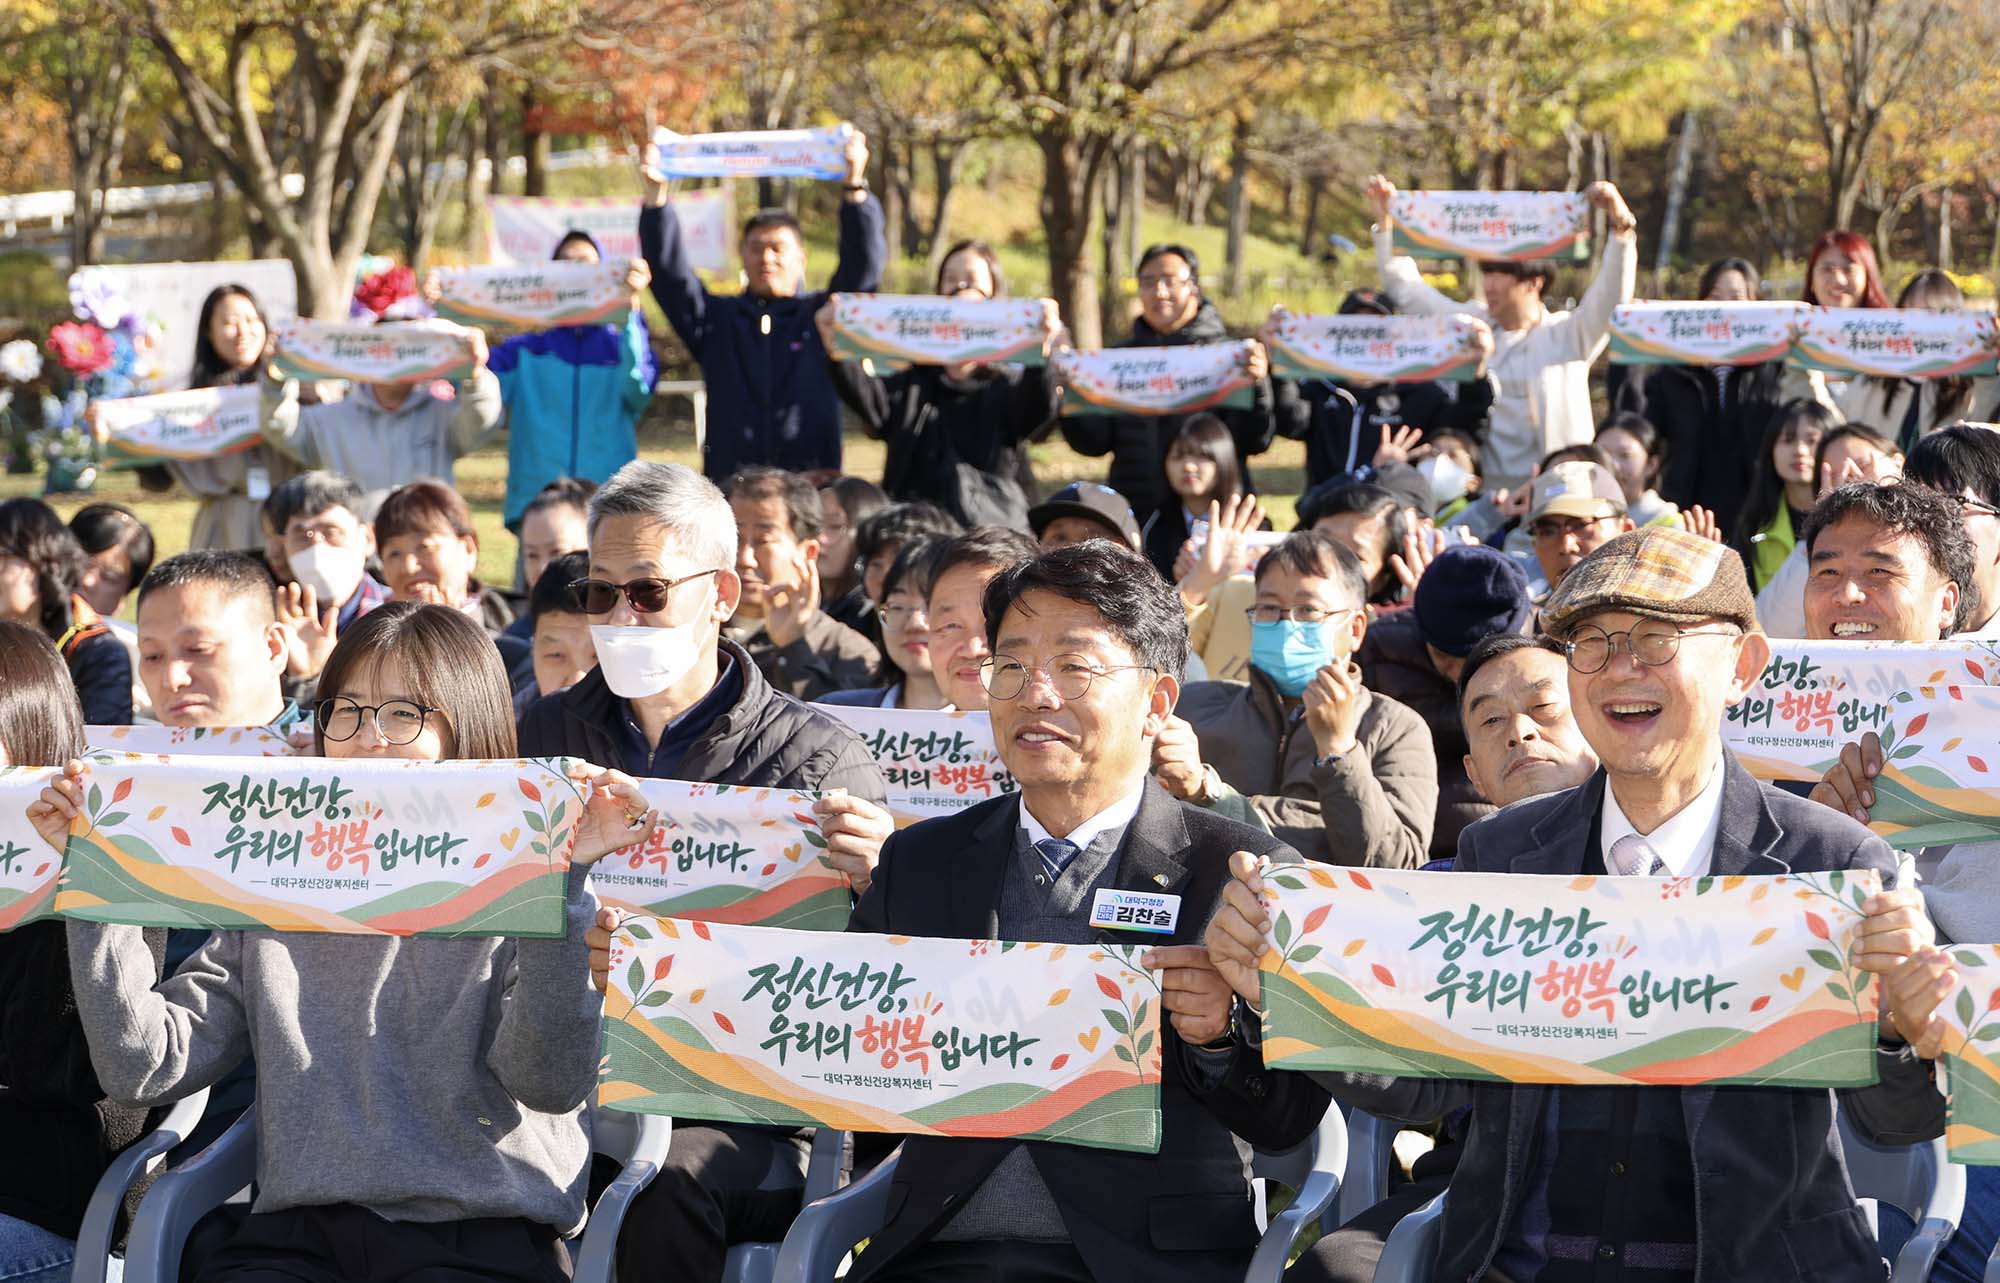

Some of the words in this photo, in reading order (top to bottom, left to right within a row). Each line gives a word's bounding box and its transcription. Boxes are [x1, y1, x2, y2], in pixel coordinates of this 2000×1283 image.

[1760, 655, 1822, 690] 건강,
[1726, 697, 1774, 728] 리의
[1776, 691, 1888, 736] 행복입니
[1747, 735, 1834, 749] 대덕구정신건강복지센터
[882, 766, 931, 790] 리의
[201, 774, 355, 824] 정신건강,
[909, 796, 978, 807] 대덕구정신건강복지
[214, 824, 304, 874] 우리의
[305, 819, 469, 877] 행복입니다.
[270, 876, 370, 890] 대덕구정신건강복지센터
[589, 872, 668, 889] 덕구정신건강복지센터
[1124, 895, 1165, 907] 대덕구청장
[1116, 906, 1172, 926] 김찬술
[1408, 903, 1609, 961] 정신건강,
[742, 956, 917, 1013] 정신건강,
[1424, 962, 1532, 1019] 우리의
[1535, 958, 1739, 1024] 행복입니다.
[1496, 1024, 1619, 1040] 대덕구정신건강복지센터
[760, 1013, 852, 1067] 우리의
[854, 1014, 1041, 1076] 행복입니다.
[823, 1071, 933, 1091] 대덕구정신건강복지센터
